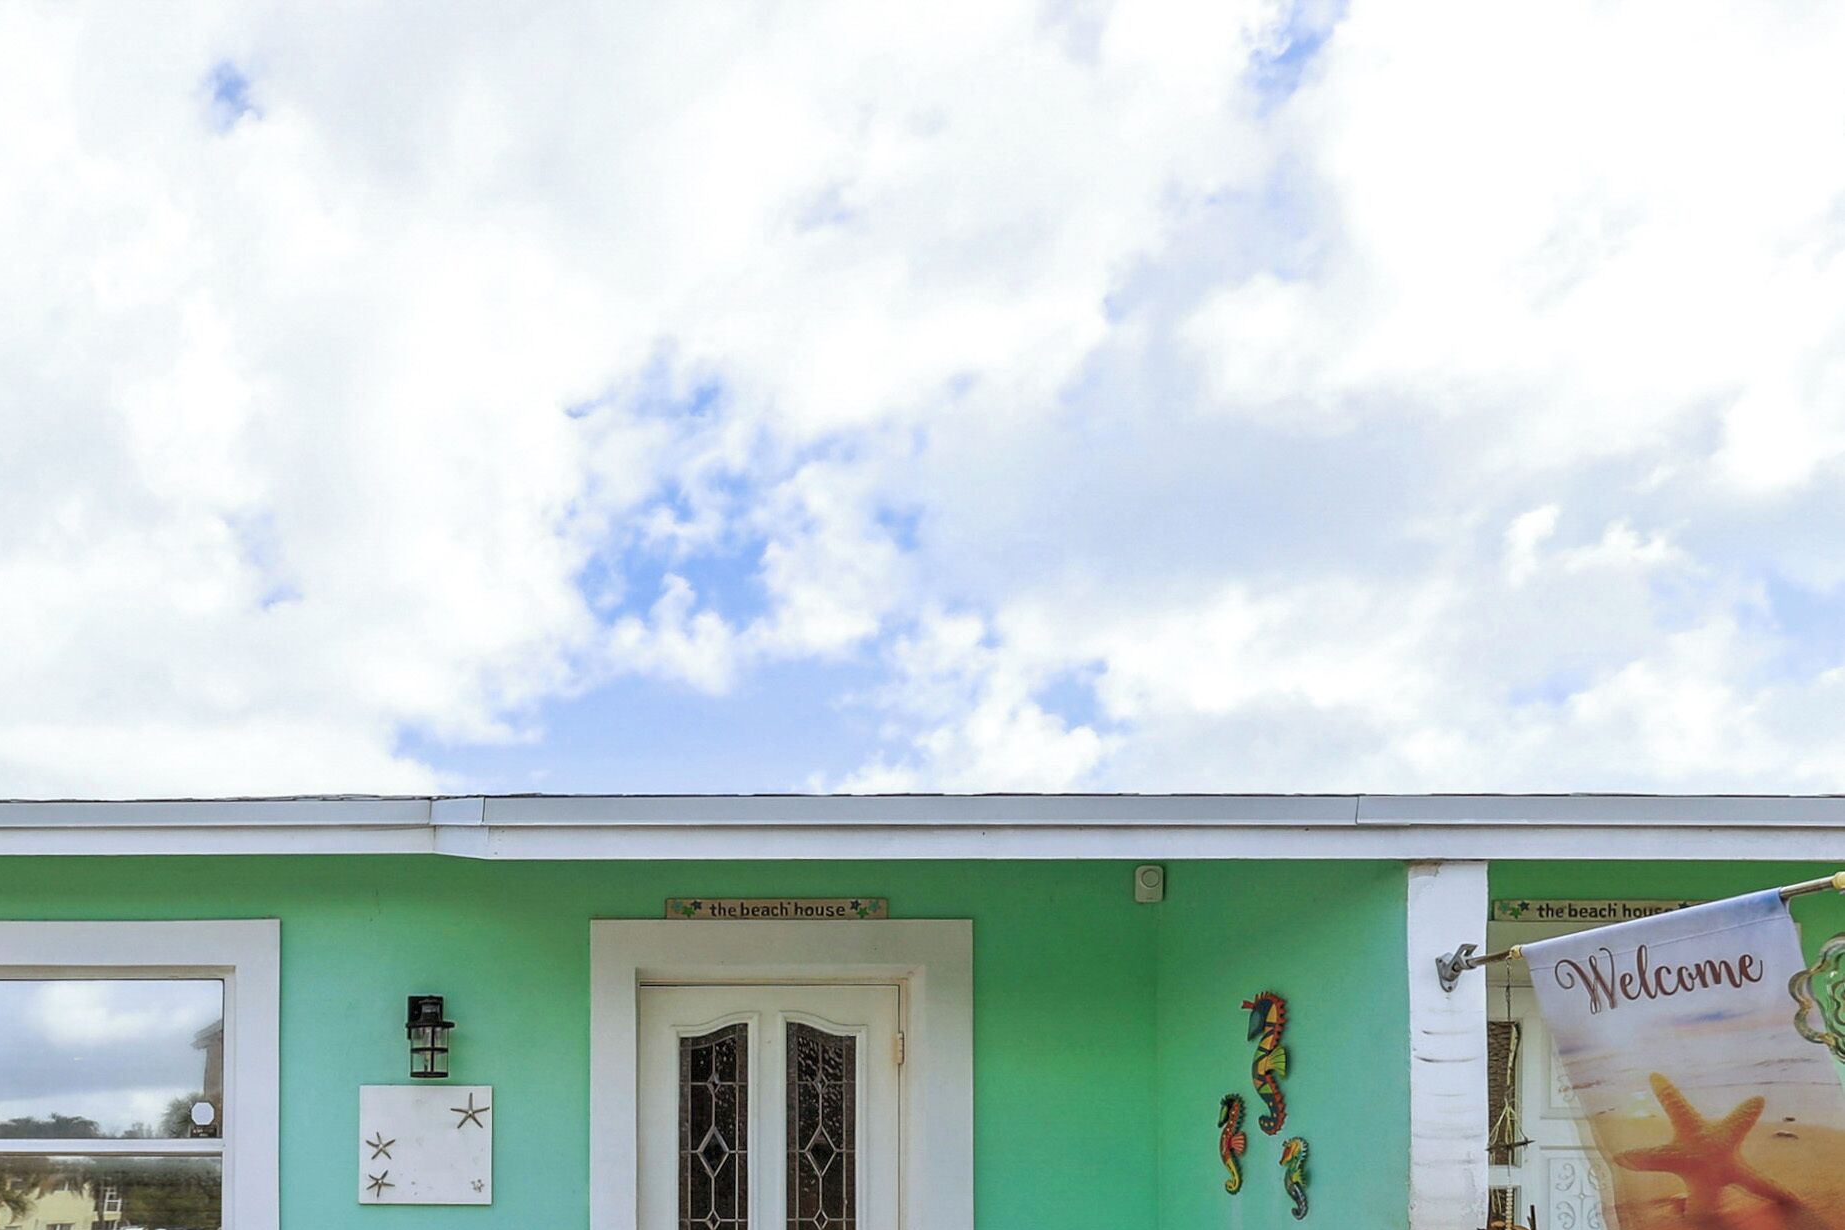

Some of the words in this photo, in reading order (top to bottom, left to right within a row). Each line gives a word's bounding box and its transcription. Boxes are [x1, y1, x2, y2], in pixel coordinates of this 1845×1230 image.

[709, 902, 738, 917] the
[741, 902, 789, 917] beach
[795, 902, 845, 917] house
[1536, 903, 1563, 918] the
[1568, 903, 1616, 918] beach
[1554, 944, 1763, 1015] Welcome
